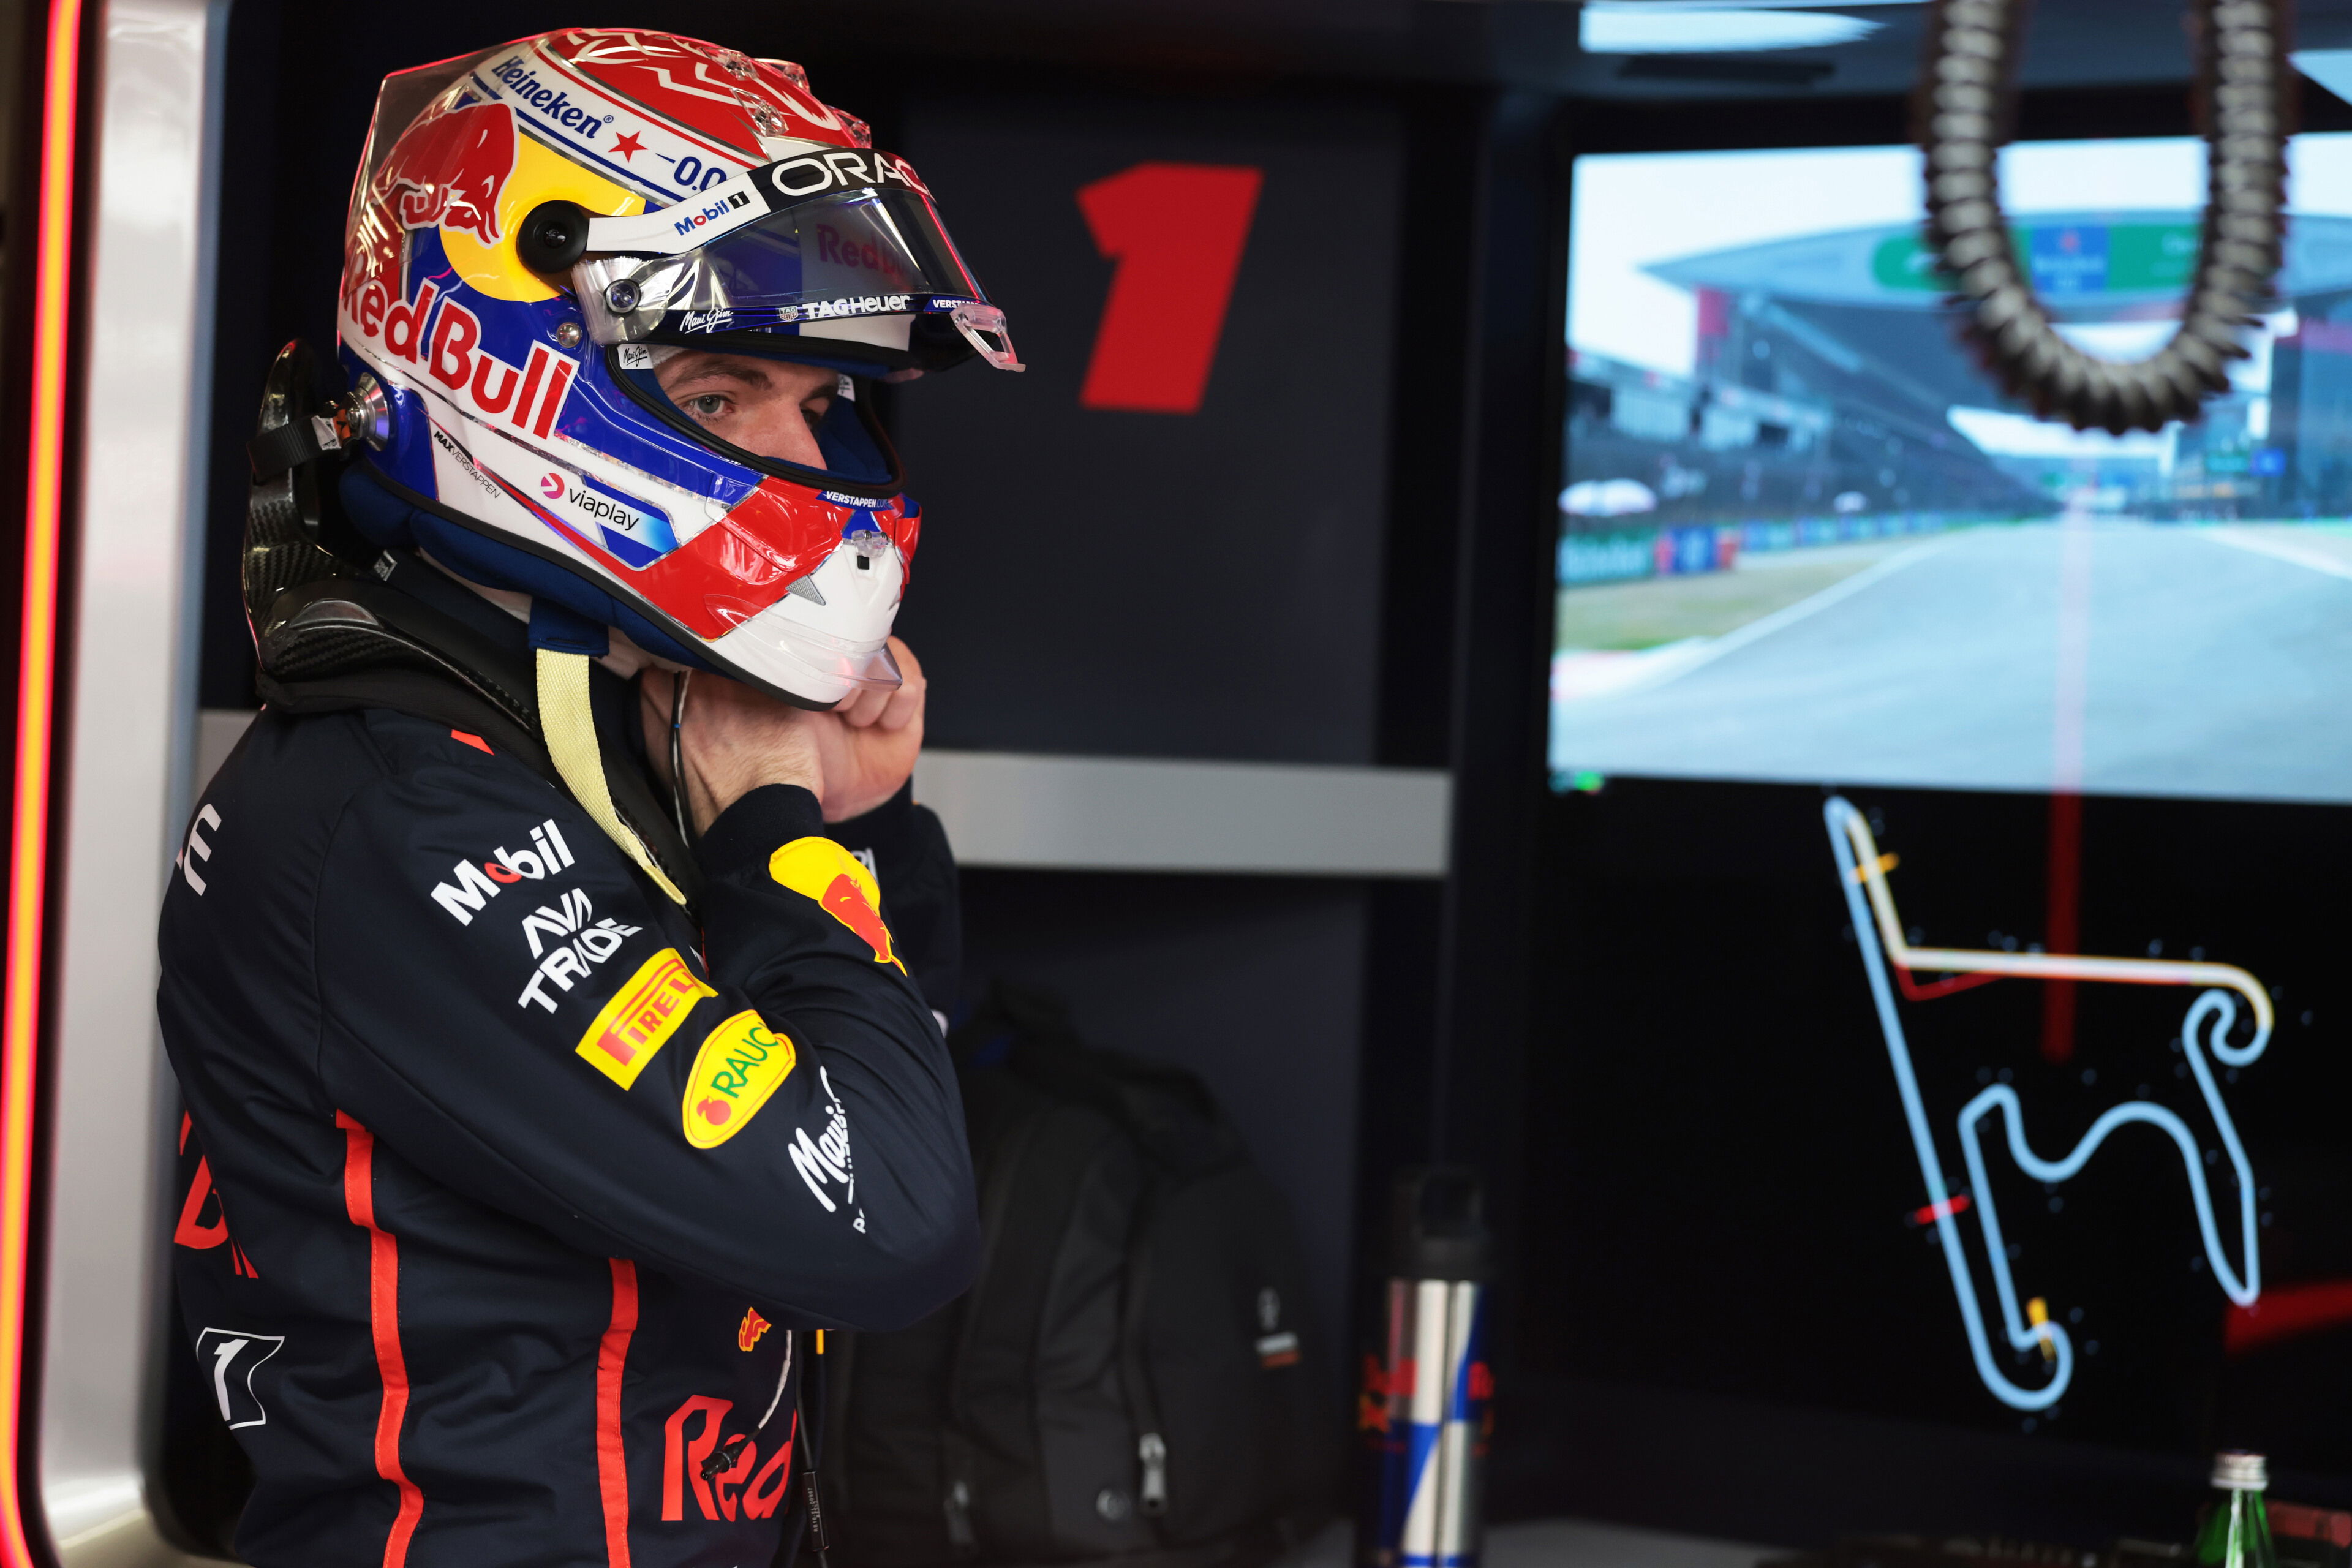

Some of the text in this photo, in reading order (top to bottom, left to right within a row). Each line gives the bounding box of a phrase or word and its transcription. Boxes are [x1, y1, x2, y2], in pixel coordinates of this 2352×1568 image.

[772, 151, 930, 196] ORAC
[674, 199, 731, 236] Mobil
[679, 308, 734, 334] Maui Jim
[1074, 157, 1266, 416] 1
[429, 305, 574, 440] Bull
[635, 345, 647, 368] Jim
[569, 488, 640, 532] viaplay
[430, 818, 575, 926] Mobil
[518, 918, 643, 1014] TRADE
[596, 958, 701, 1067] PIREL
[710, 1022, 780, 1099] RAUC
[213, 1338, 250, 1422] 1
